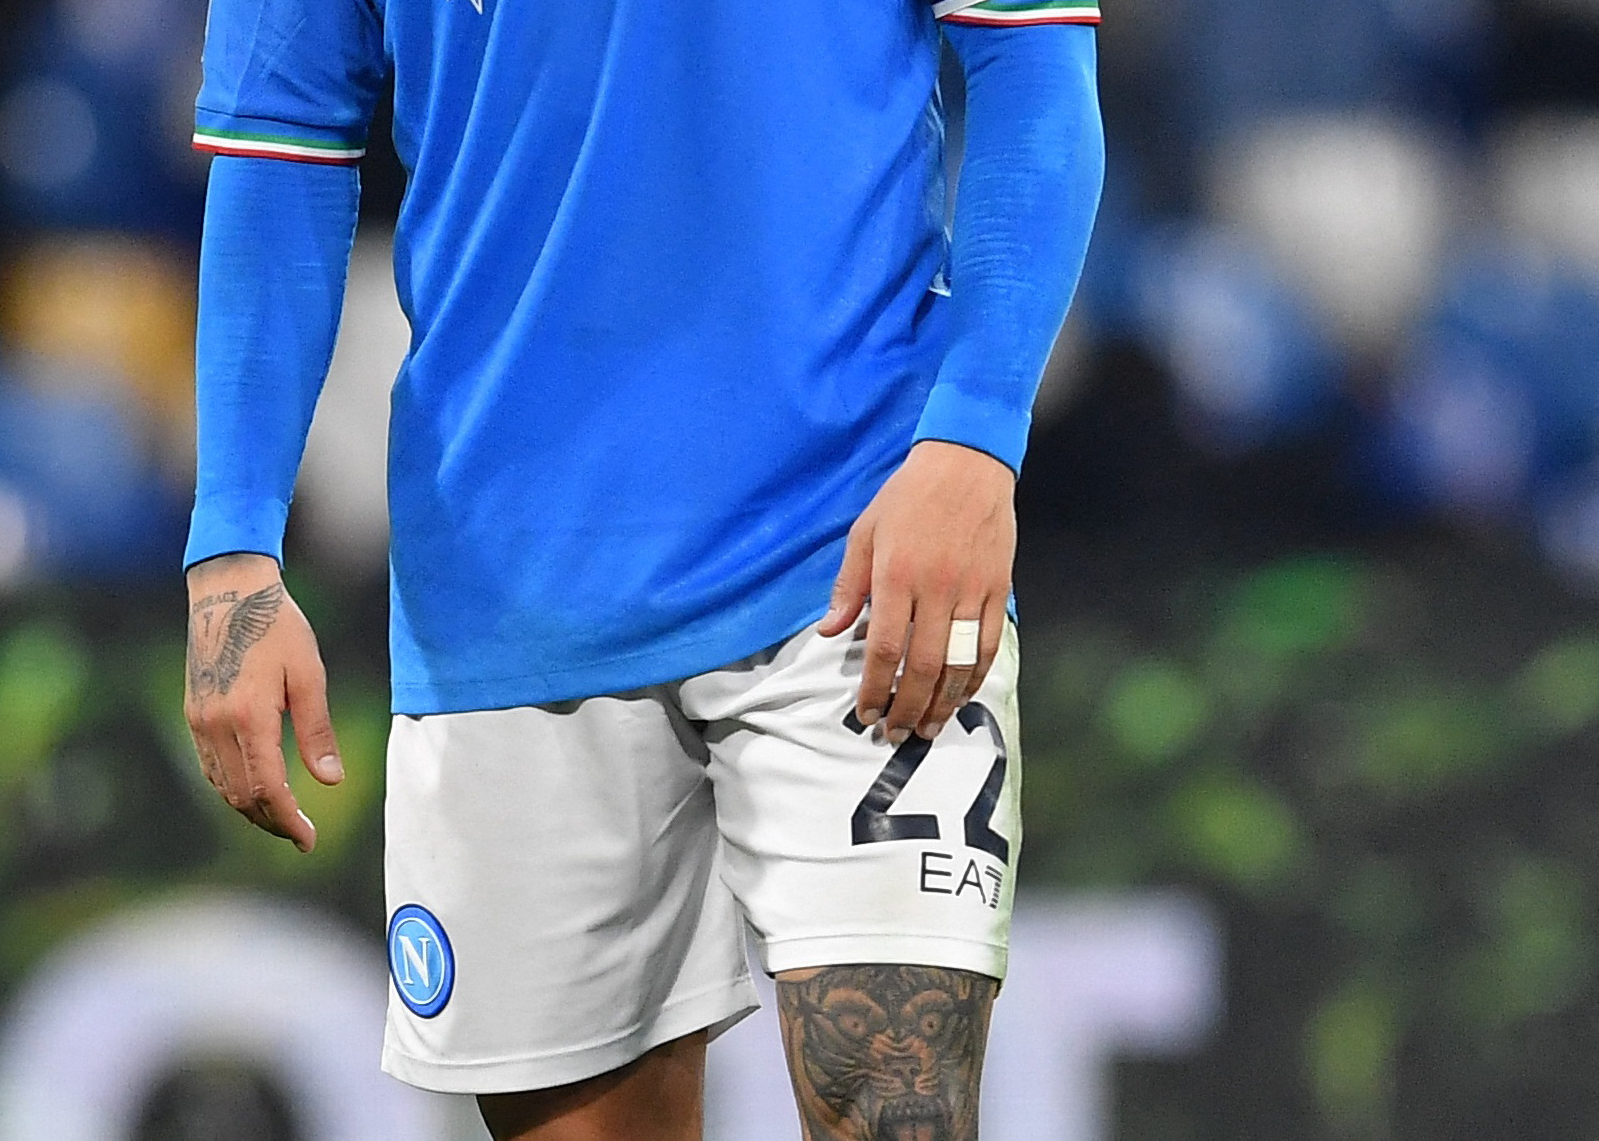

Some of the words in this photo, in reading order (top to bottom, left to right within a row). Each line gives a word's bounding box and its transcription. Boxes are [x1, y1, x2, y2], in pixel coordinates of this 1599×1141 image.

[842, 692, 1010, 867] 22
[919, 850, 1004, 909] EA7
[400, 935, 433, 989] N
